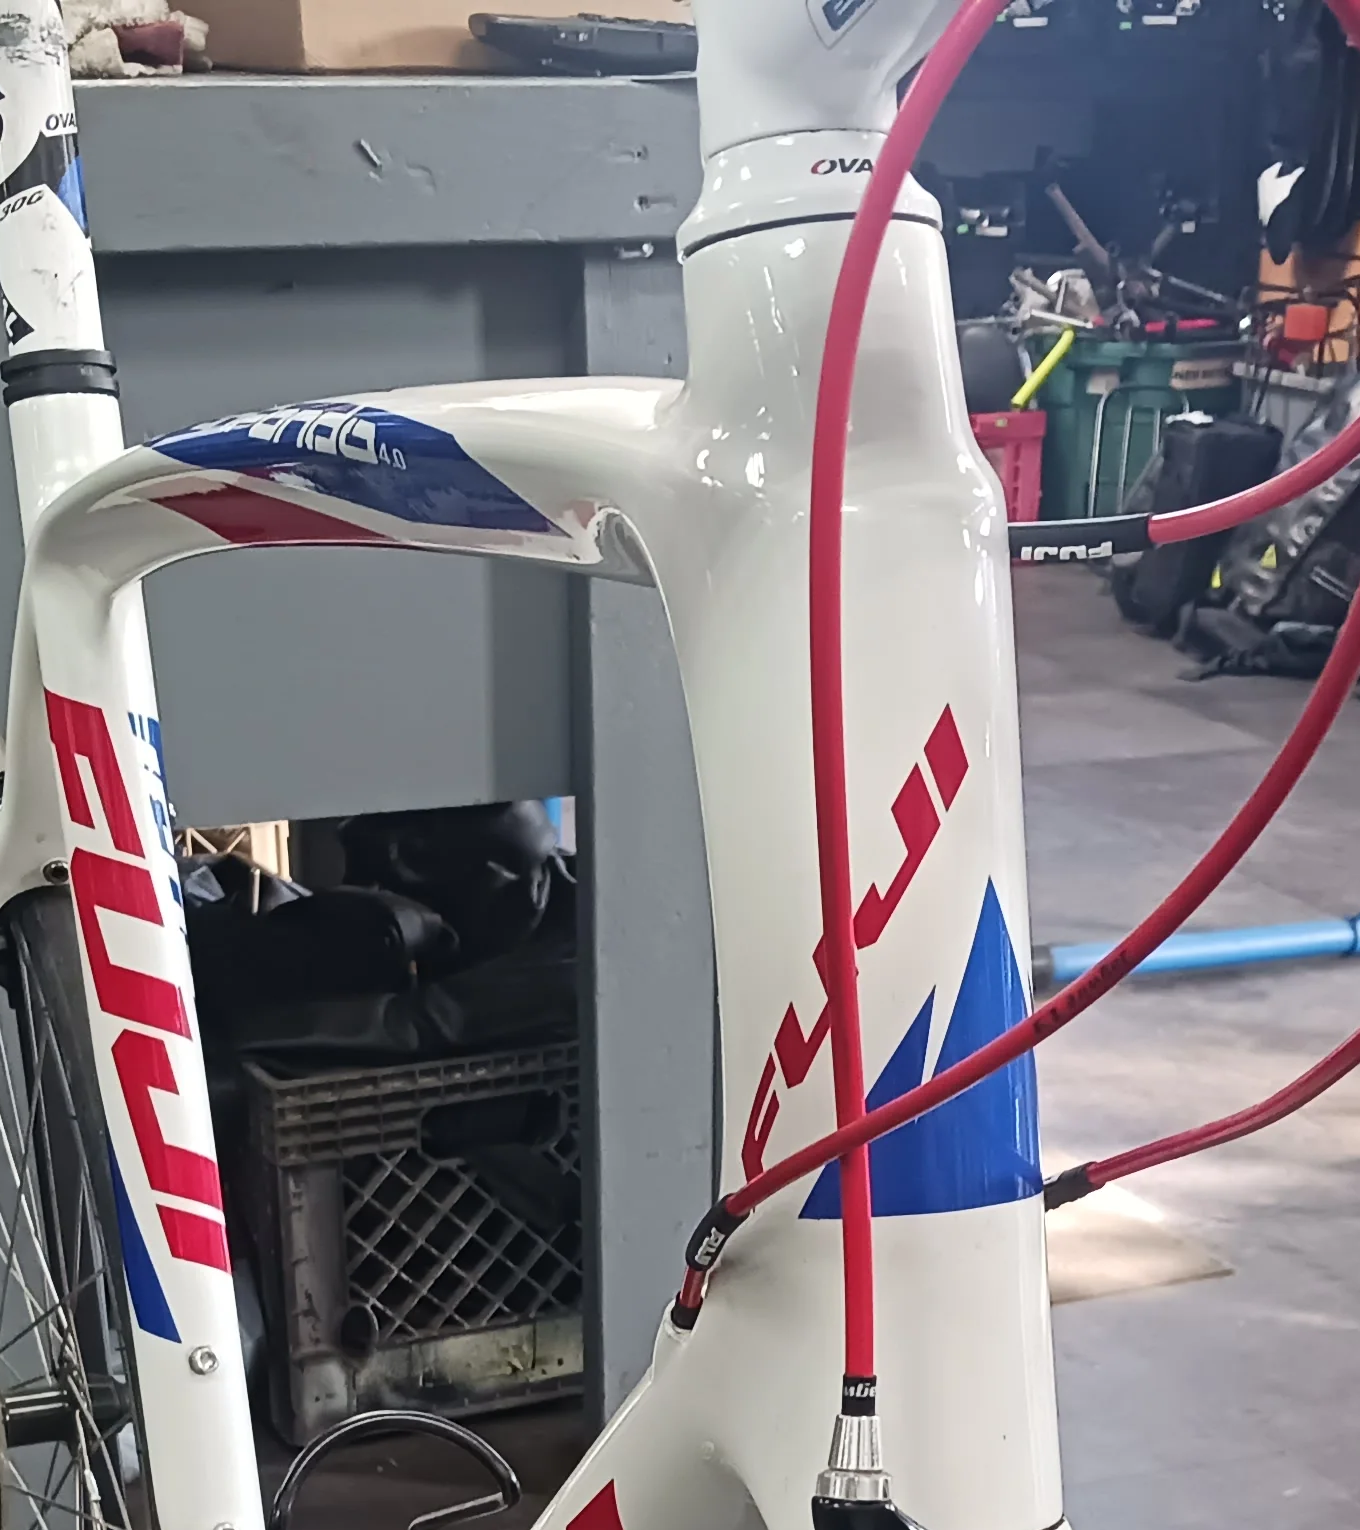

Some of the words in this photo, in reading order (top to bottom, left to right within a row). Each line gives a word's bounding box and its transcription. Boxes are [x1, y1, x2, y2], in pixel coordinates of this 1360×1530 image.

[45, 112, 77, 131] OVA
[810, 158, 874, 175] OVA
[378, 442, 407, 471] 4.0
[42, 687, 233, 1275] FUJI
